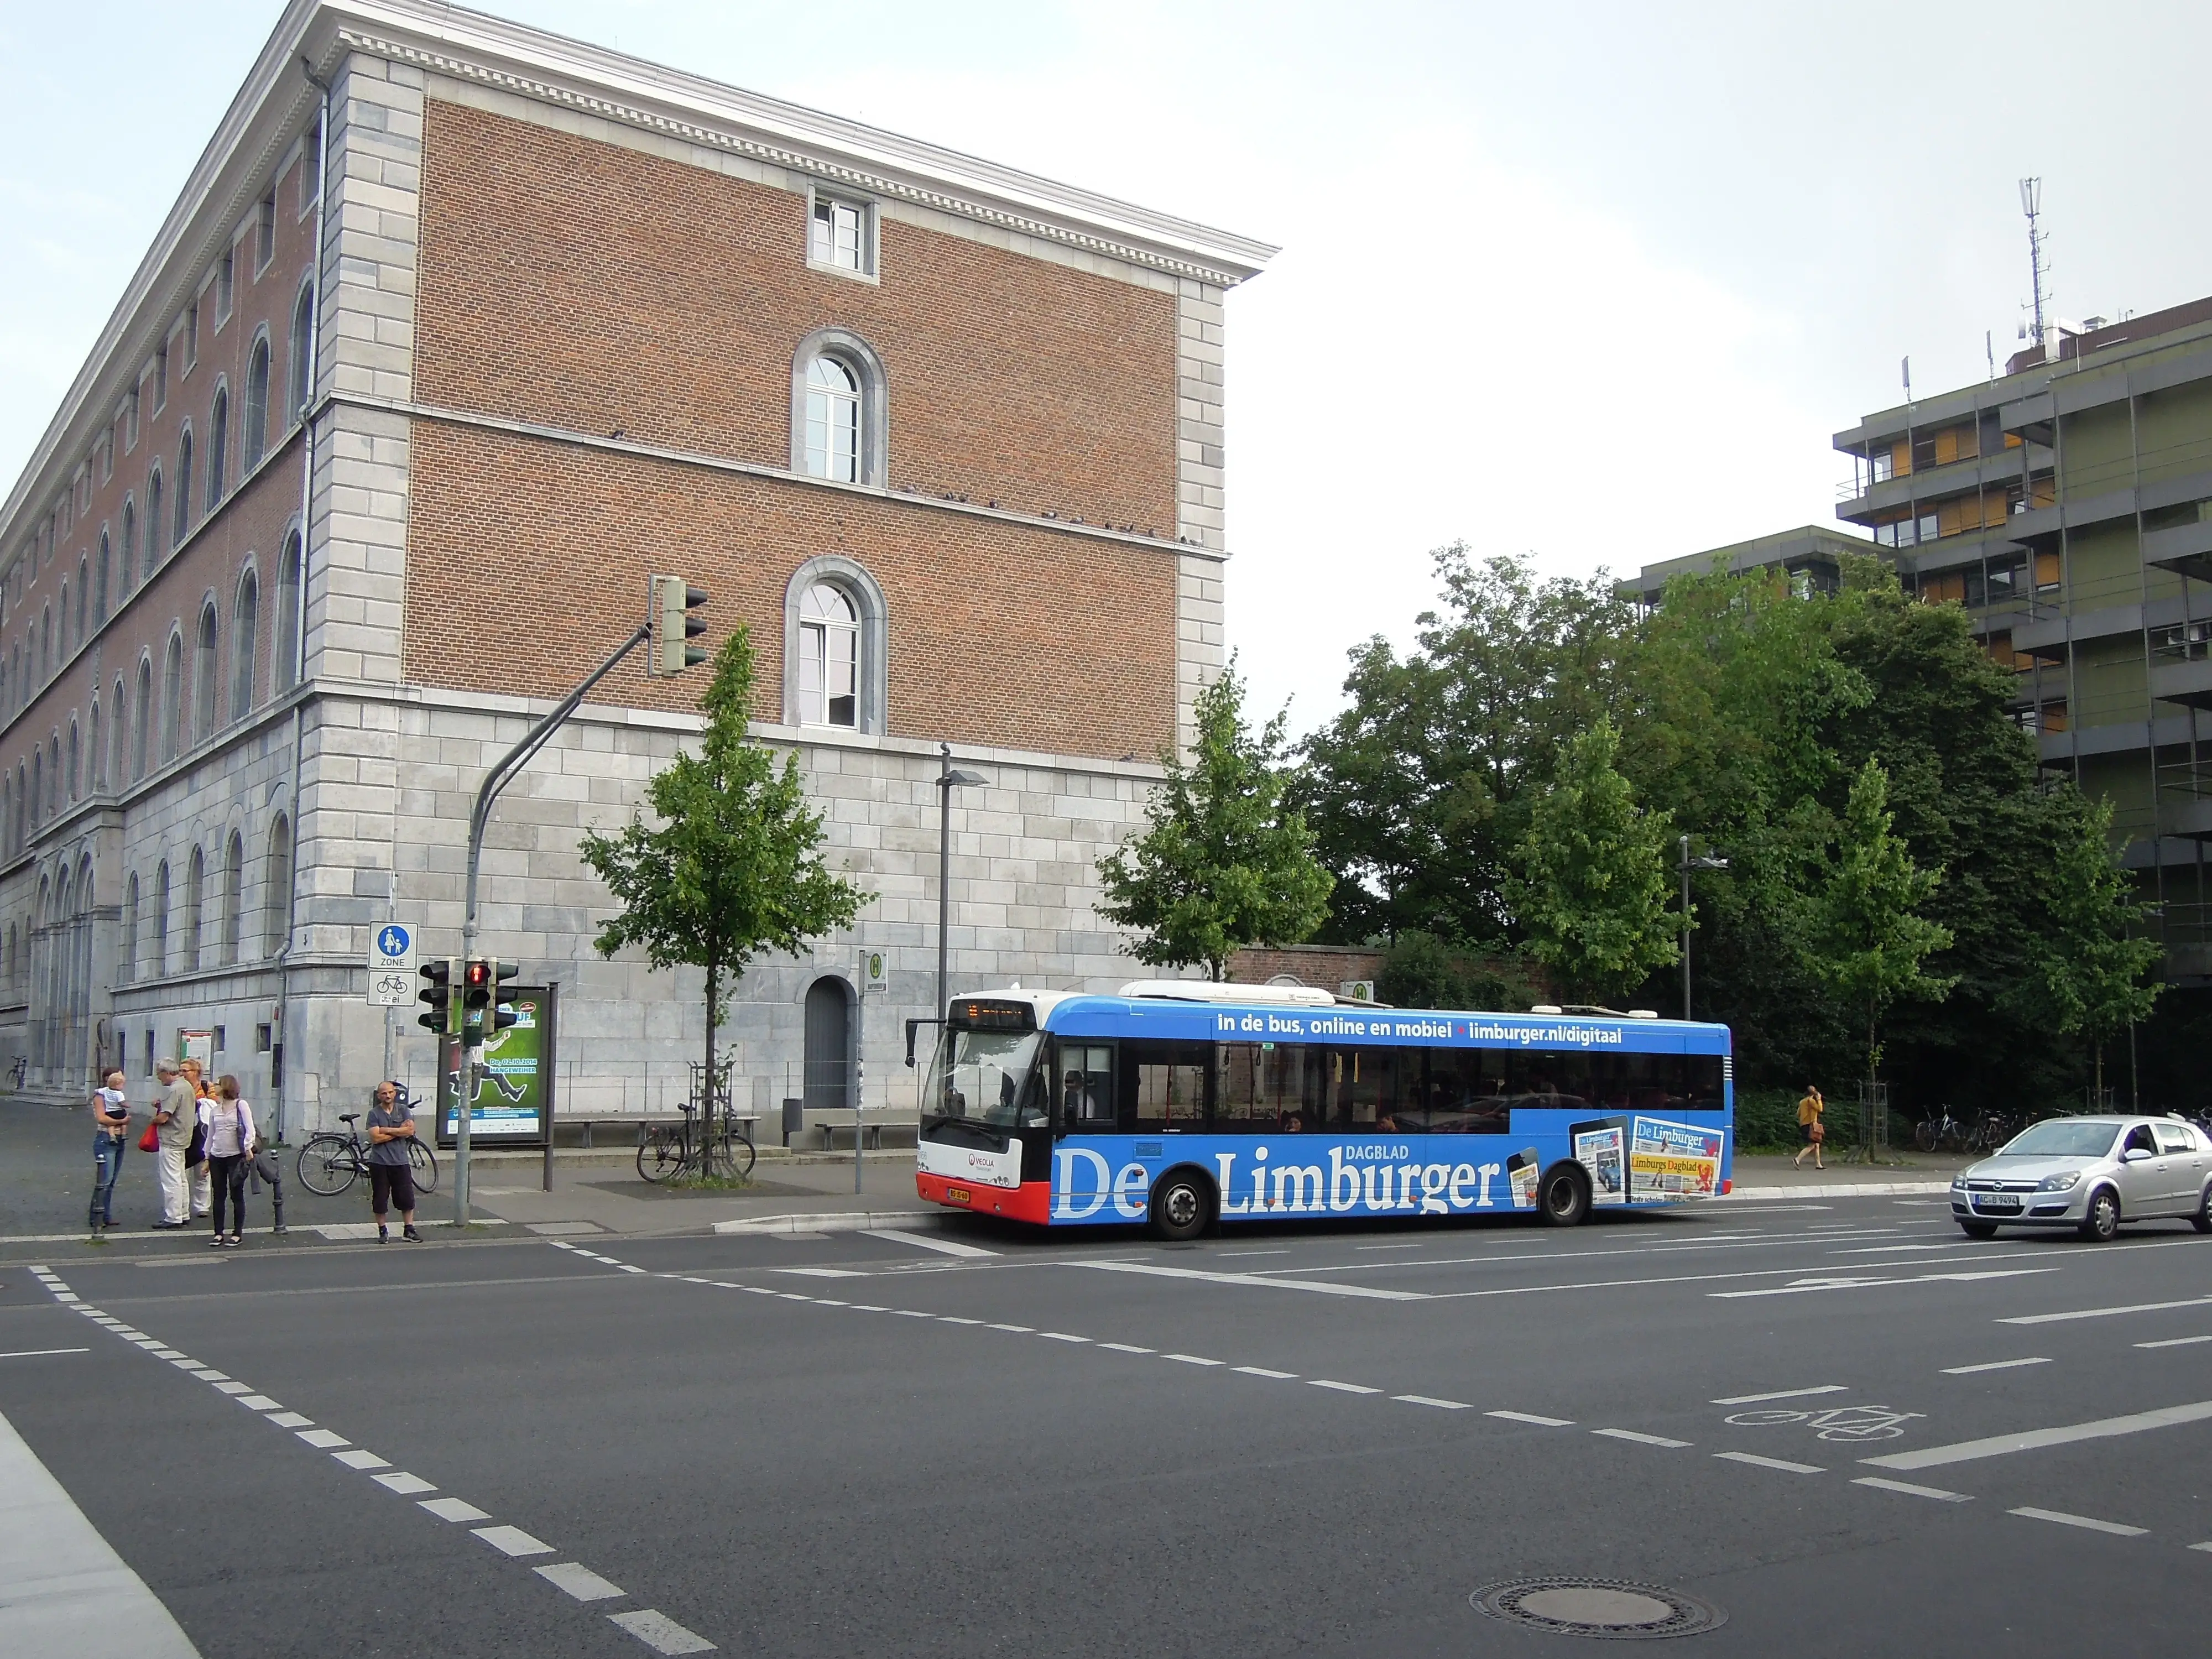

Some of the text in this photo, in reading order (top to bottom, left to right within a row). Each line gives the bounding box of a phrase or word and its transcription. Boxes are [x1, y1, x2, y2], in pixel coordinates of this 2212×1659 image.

[380, 958, 405, 967] ZONE
[1218, 1013, 1622, 1047] in de bus, online en mobiel limburger.nl/digitaal
[1639, 1123, 1652, 1138] De
[1653, 1125, 1703, 1149] Limburger
[1345, 1145, 1409, 1160] DAGBLAD
[975, 1157, 994, 1167] VEOLIA
[1631, 1157, 1697, 1173] Limburgs Dagblad
[1051, 1146, 1500, 1219] De Limburger
